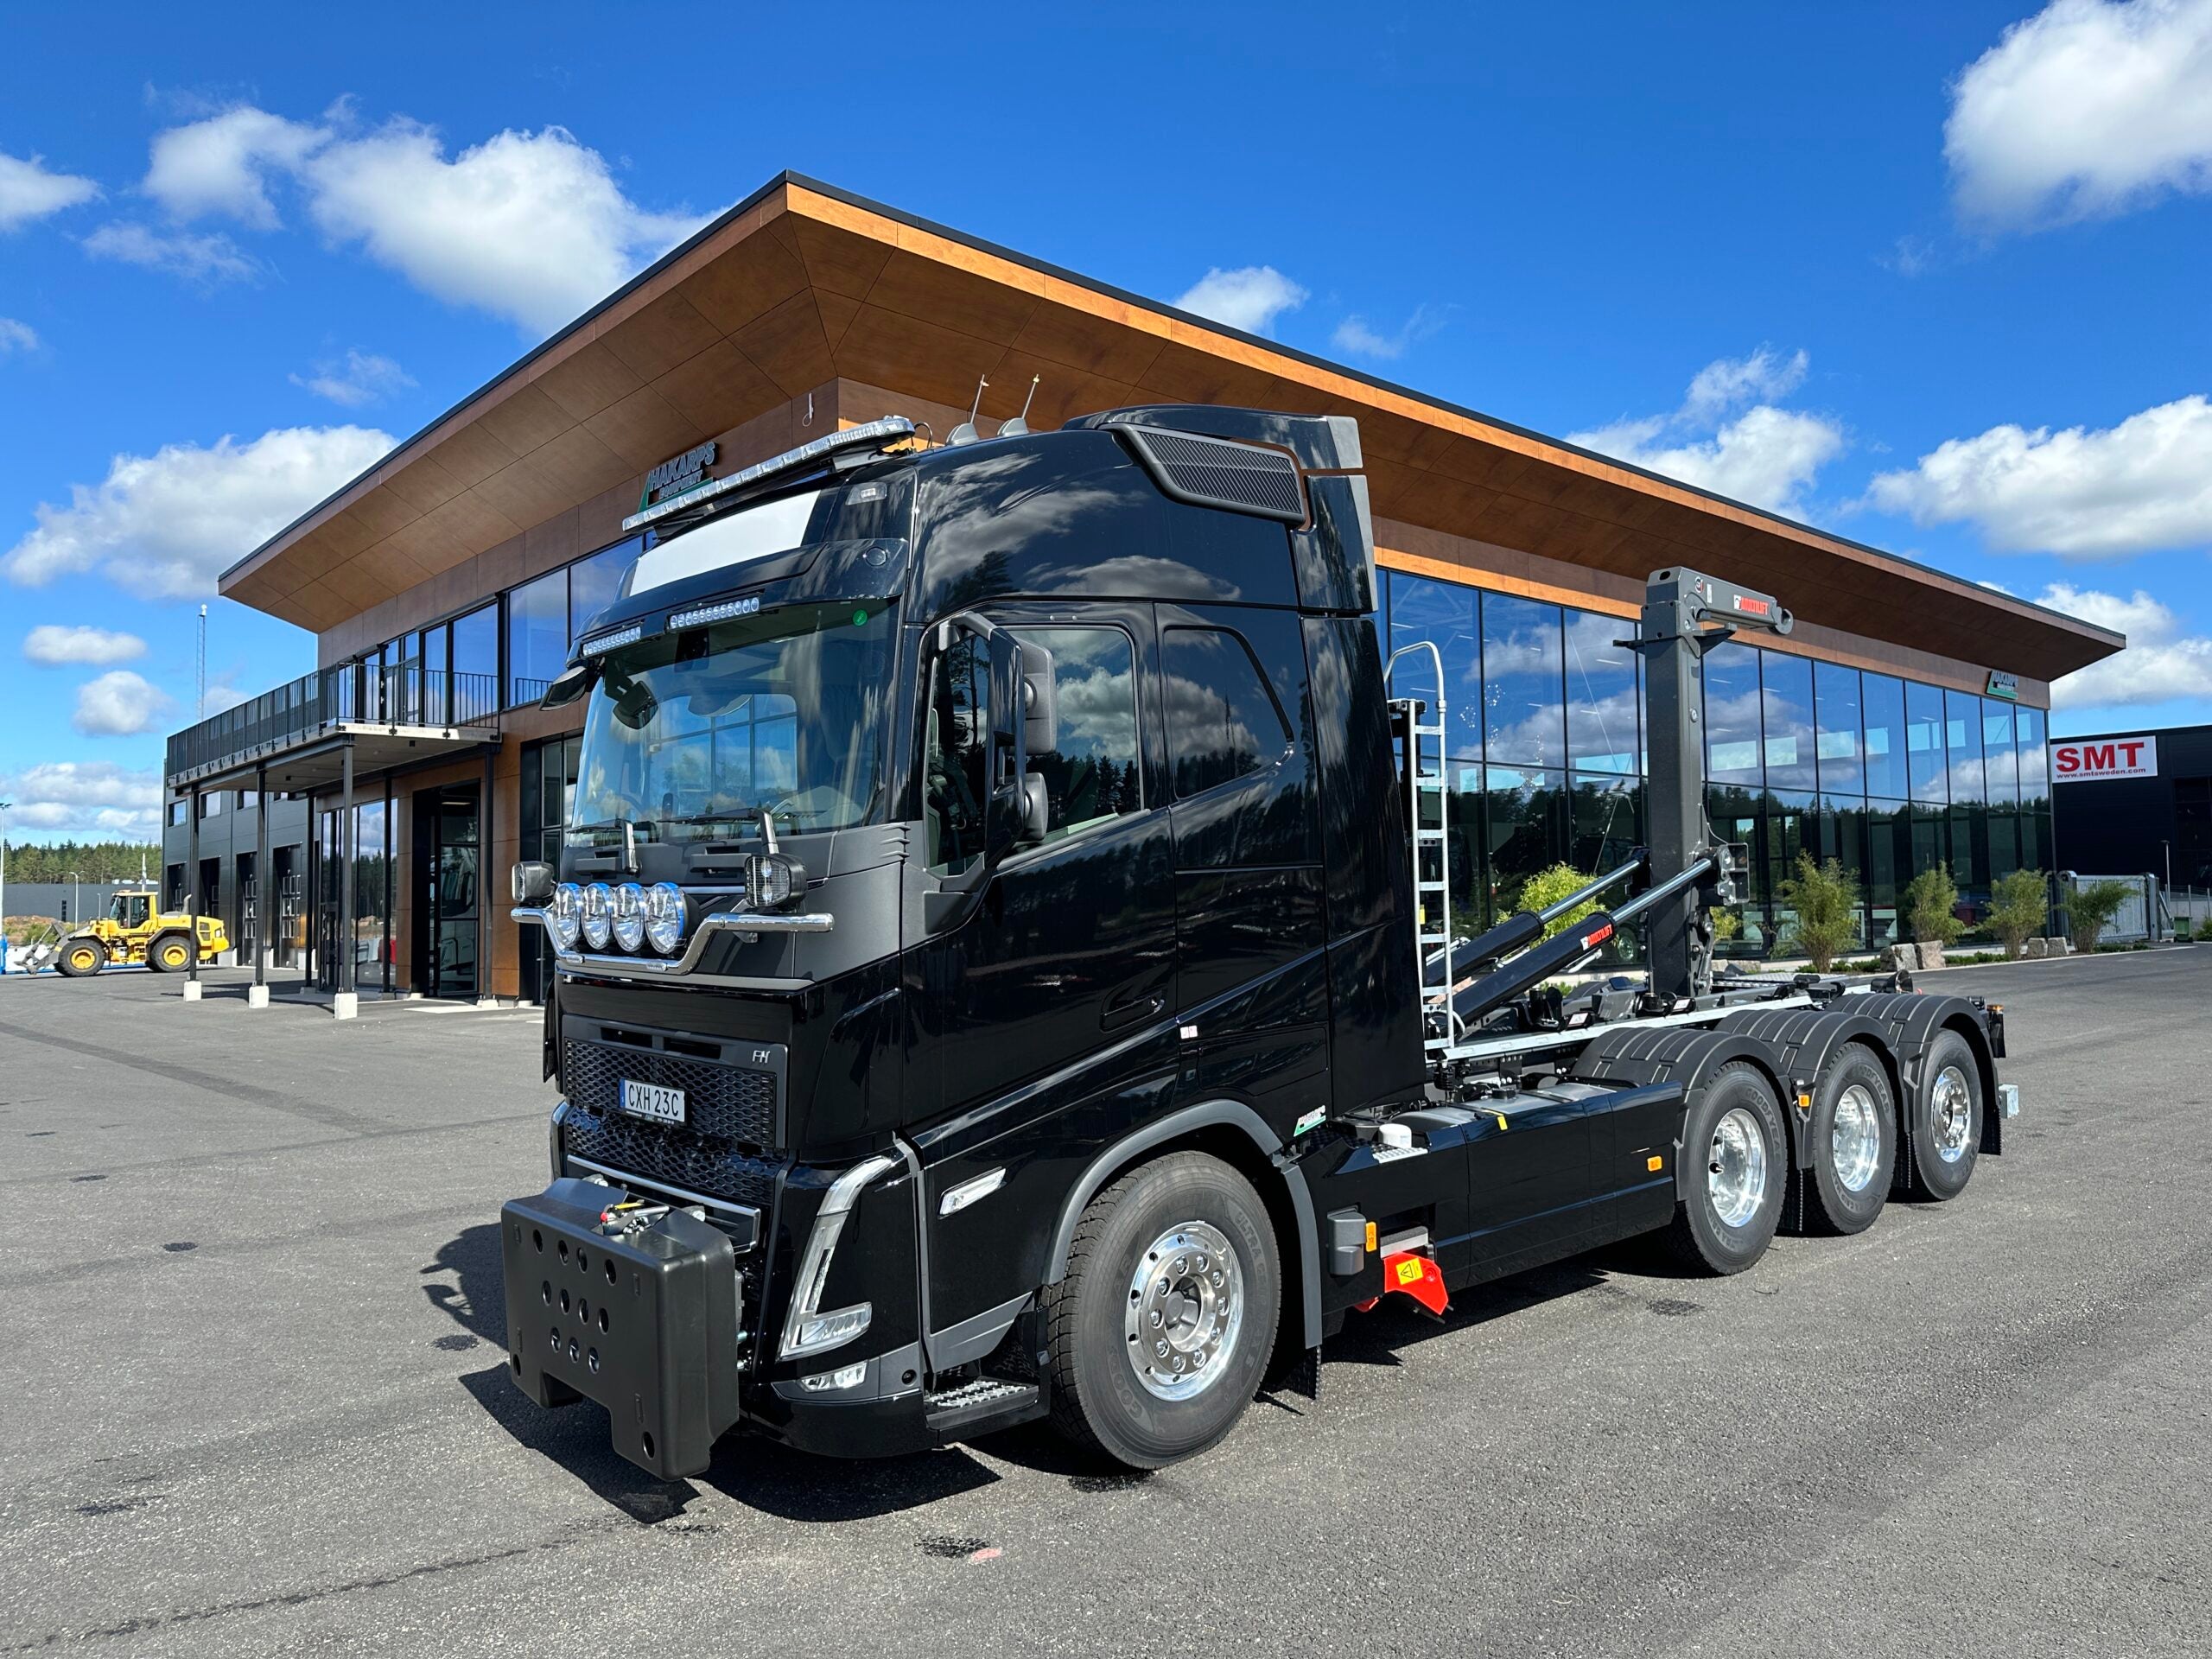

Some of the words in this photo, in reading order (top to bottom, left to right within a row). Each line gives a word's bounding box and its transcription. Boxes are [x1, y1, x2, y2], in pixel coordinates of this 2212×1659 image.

[649, 442, 715, 491] HAKARPS
[658, 470, 702, 499] EQUIPMENT
[2056, 741, 2145, 772] SMT
[2056, 767, 2146, 779] www.smtsweden.com
[752, 1050, 771, 1064] FH
[628, 1084, 651, 1111] CXH
[654, 1089, 679, 1117] 23C
[1235, 1210, 1261, 1259] ULTRA
